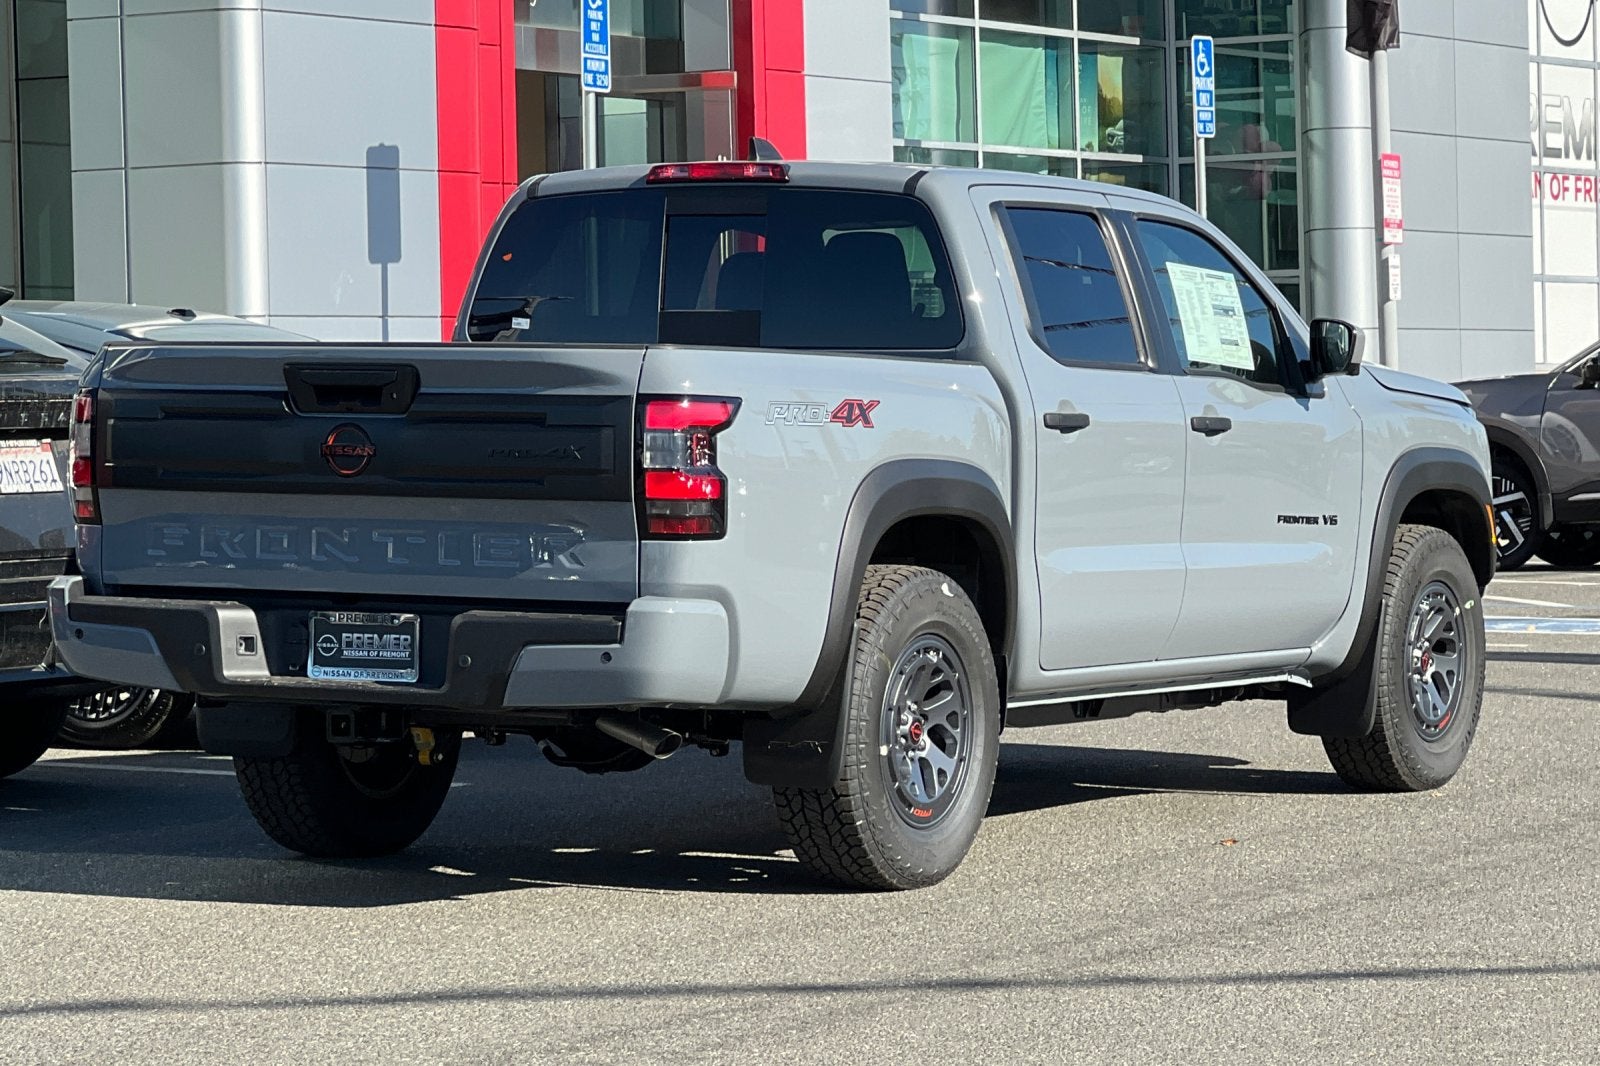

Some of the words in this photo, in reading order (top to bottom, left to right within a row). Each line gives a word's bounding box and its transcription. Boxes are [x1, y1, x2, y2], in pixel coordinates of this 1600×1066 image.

[587, 9, 603, 20] PARKING
[1550, 173, 1569, 201] OF
[765, 399, 880, 428] PRO-4X
[322, 445, 376, 456] NISSAN
[1277, 514, 1319, 525] FRONTIER
[1322, 514, 1338, 526] V6
[147, 522, 587, 569] FRONTIER
[337, 613, 392, 625] PREMIER
[341, 633, 411, 650] PREMIER
[369, 650, 378, 658] OF
[379, 651, 410, 659] FREMONT
[322, 669, 352, 678] NISSAN
[353, 670, 365, 679] OF
[366, 671, 404, 680] FREMONT
